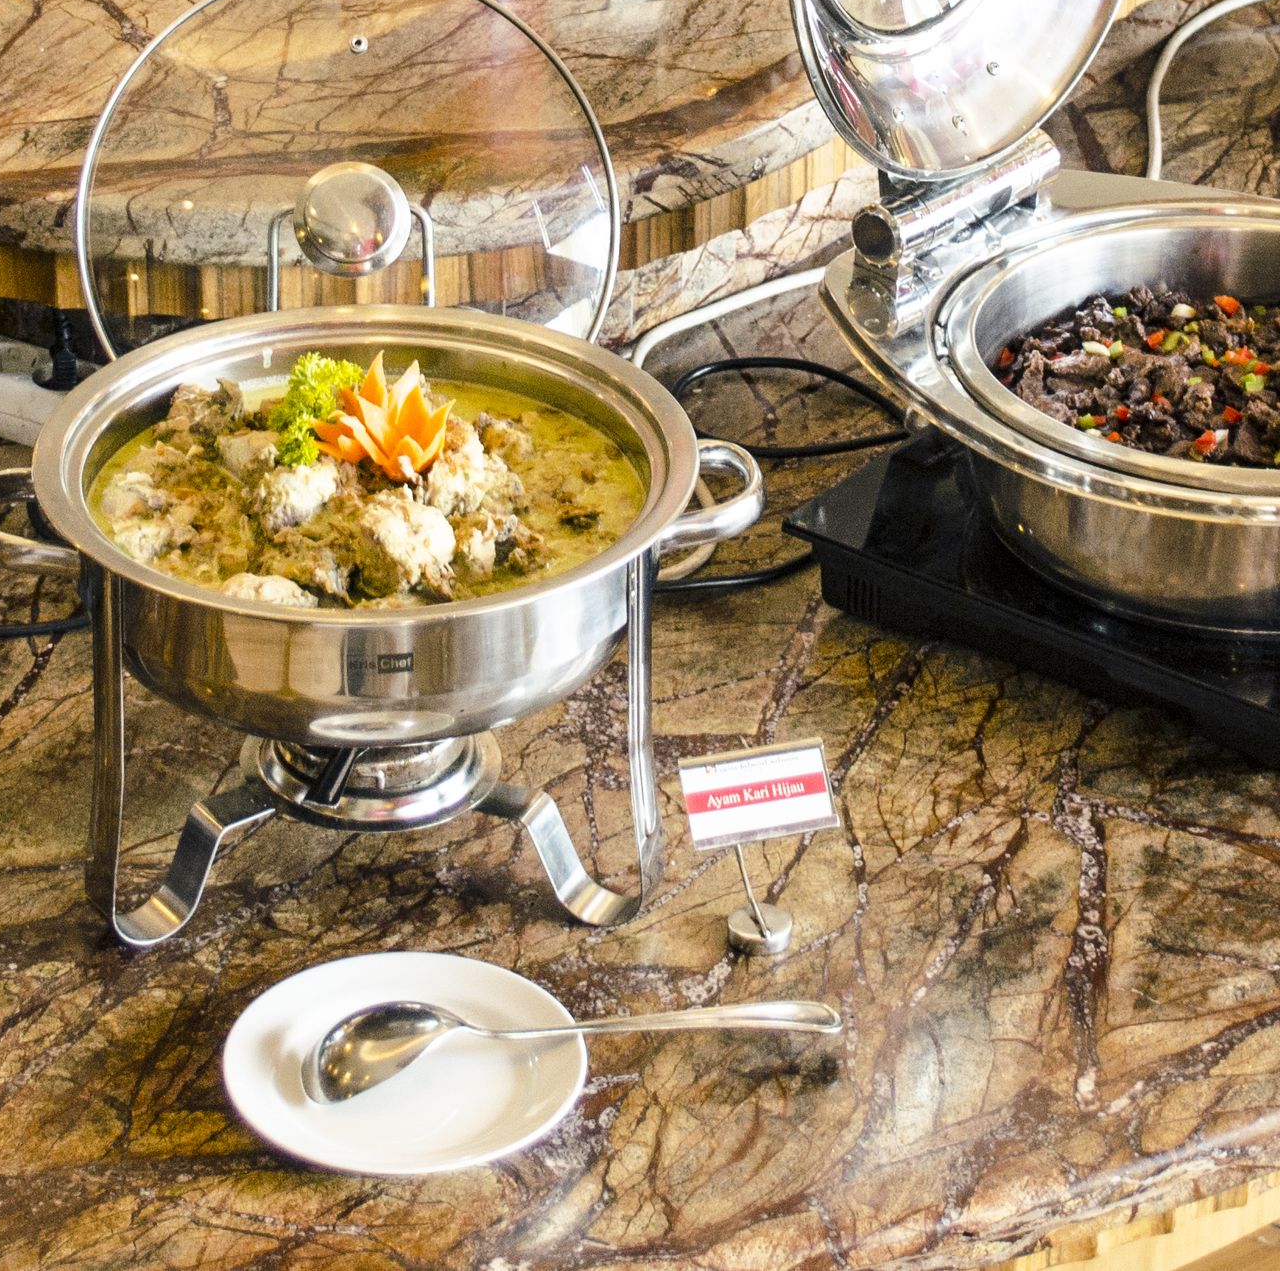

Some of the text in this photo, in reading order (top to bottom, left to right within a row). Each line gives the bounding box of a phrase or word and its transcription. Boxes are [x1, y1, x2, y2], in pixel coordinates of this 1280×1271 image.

[380, 656, 412, 669] Chef
[707, 781, 805, 809] Ayam Kari Hijau
